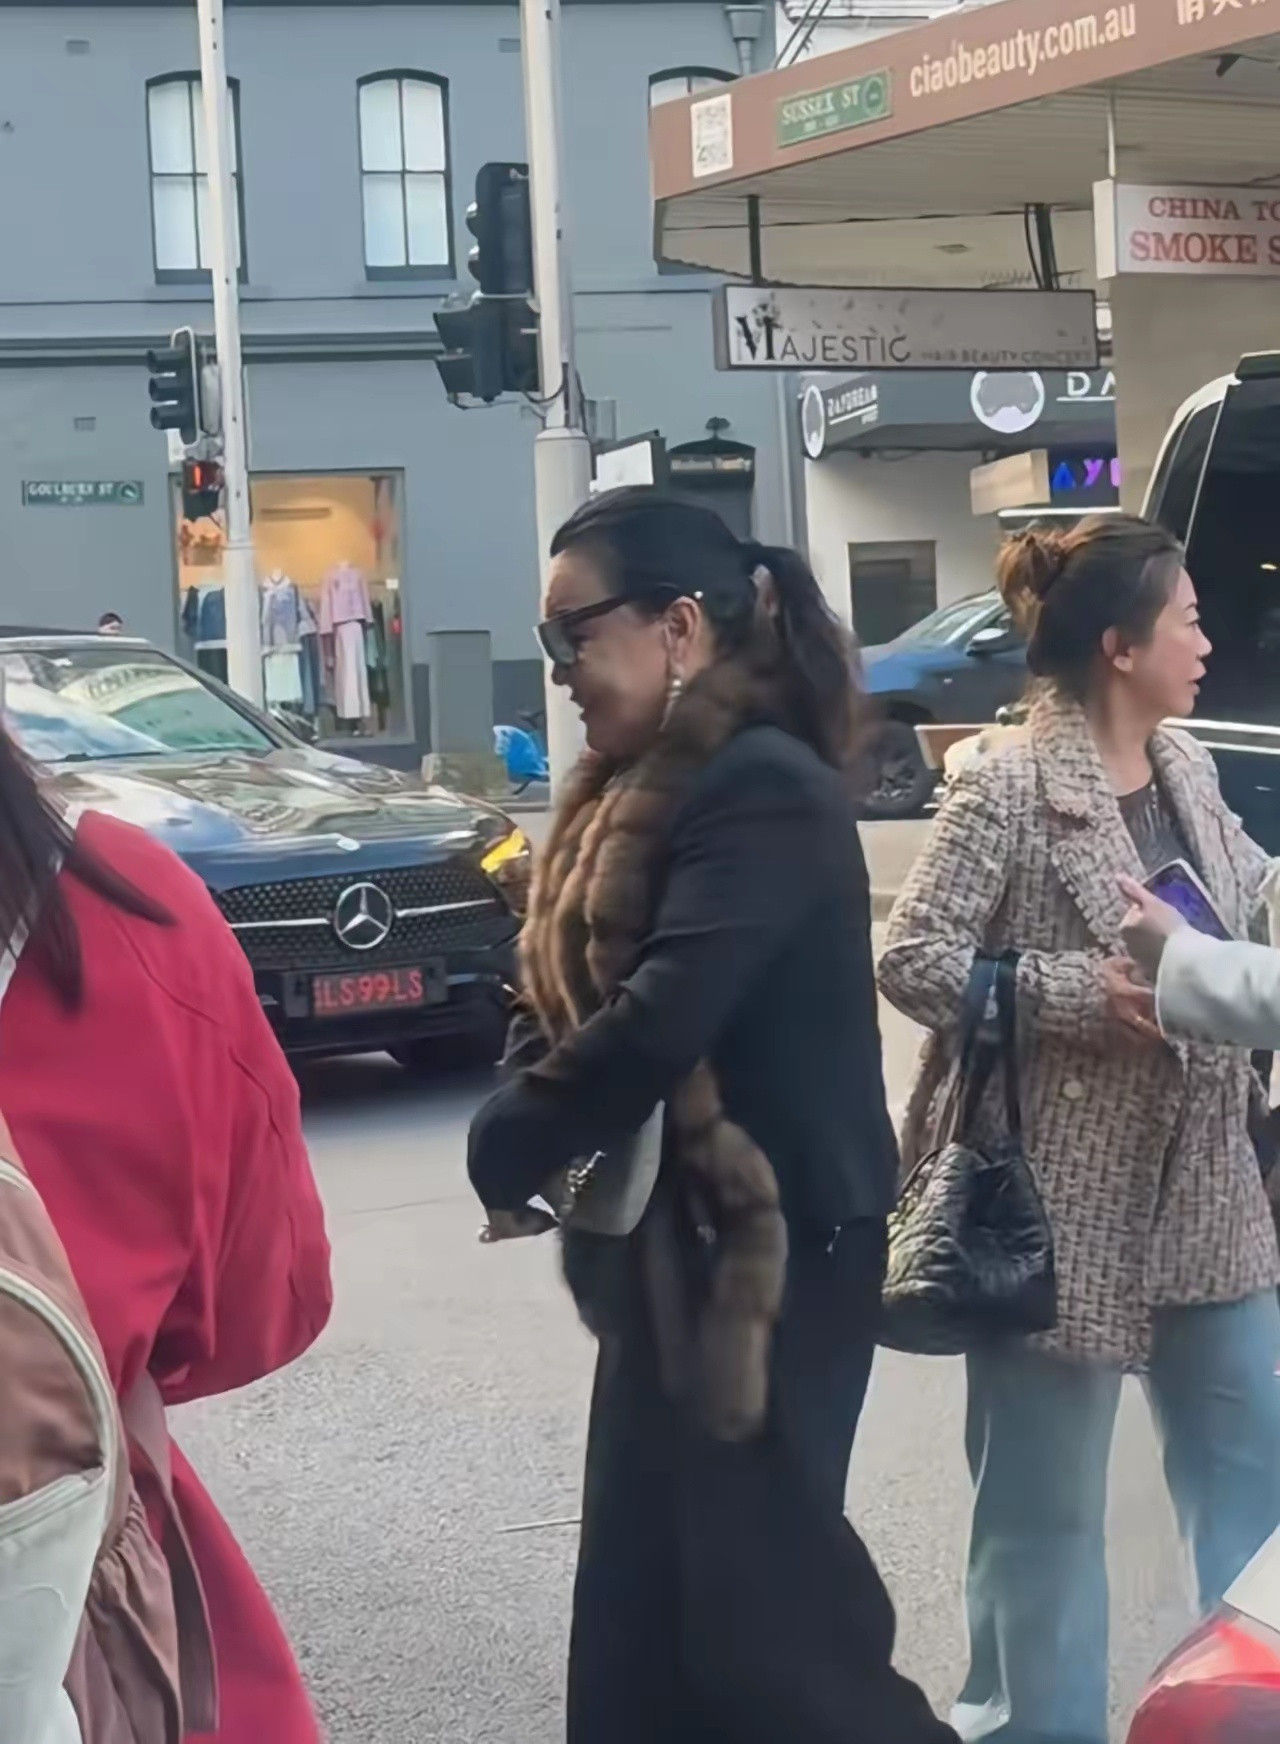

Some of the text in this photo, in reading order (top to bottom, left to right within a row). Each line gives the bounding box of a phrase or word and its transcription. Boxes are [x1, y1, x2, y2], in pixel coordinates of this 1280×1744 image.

[909, 2, 1137, 97] ciaobeauty.com.au
[842, 85, 860, 108] ST
[1148, 196, 1241, 220] CHINA
[1129, 230, 1258, 264] SMOKE
[735, 314, 911, 362] MAJESTIC
[962, 349, 1018, 363] BEAUTY
